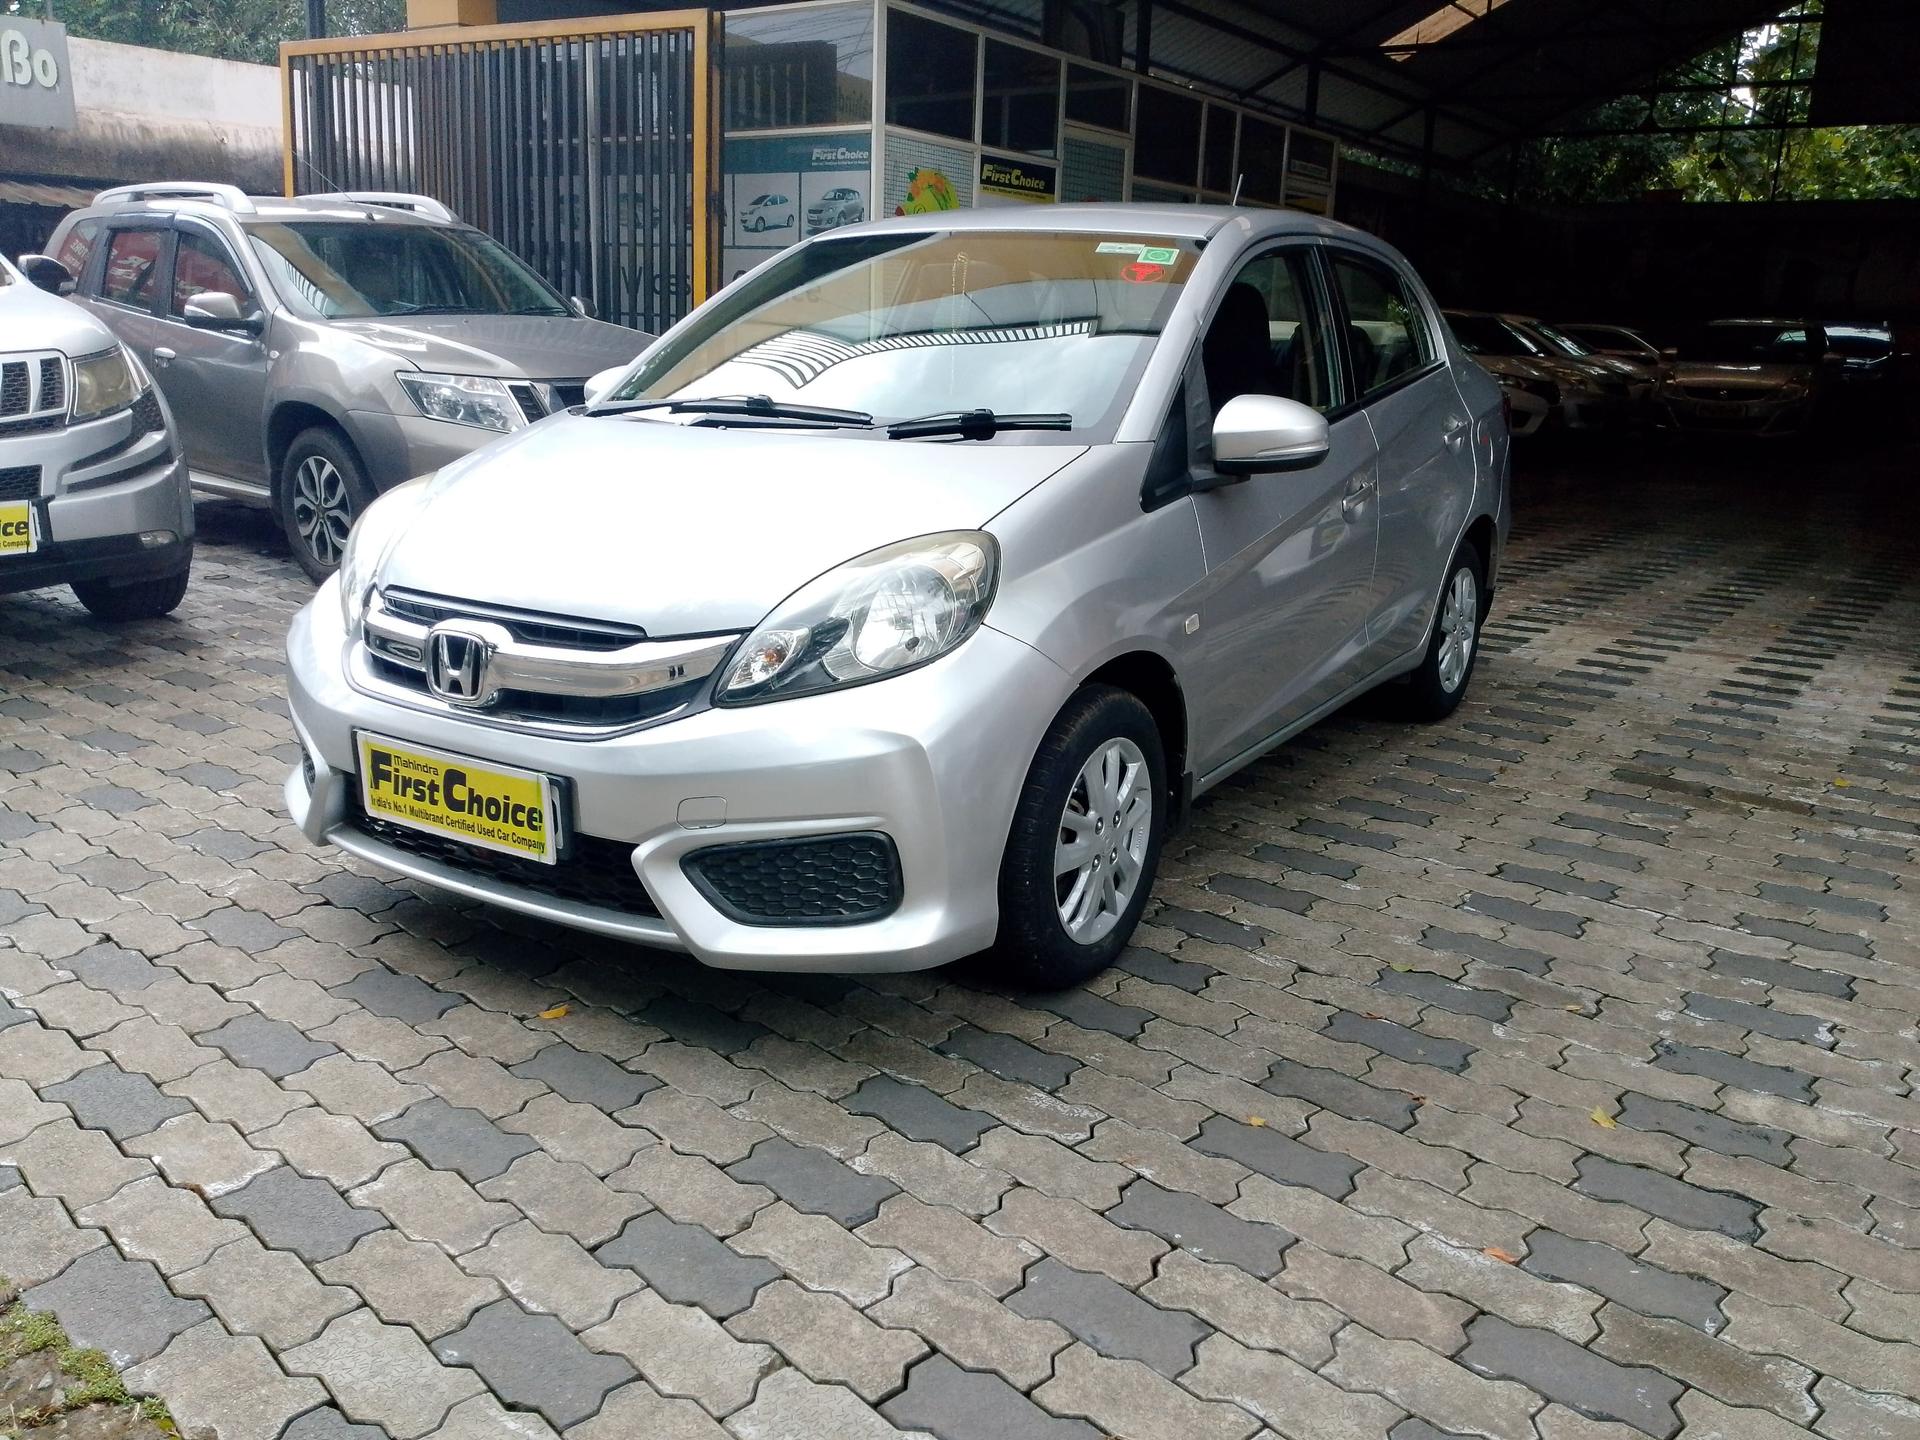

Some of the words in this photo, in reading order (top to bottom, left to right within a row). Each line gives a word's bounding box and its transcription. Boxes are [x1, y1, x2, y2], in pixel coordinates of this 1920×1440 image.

[393, 754, 439, 776] Mahindra
[409, 804, 444, 825] Multibrand
[446, 815, 475, 833] Certified
[477, 823, 495, 839] Used
[497, 828, 510, 842] Car
